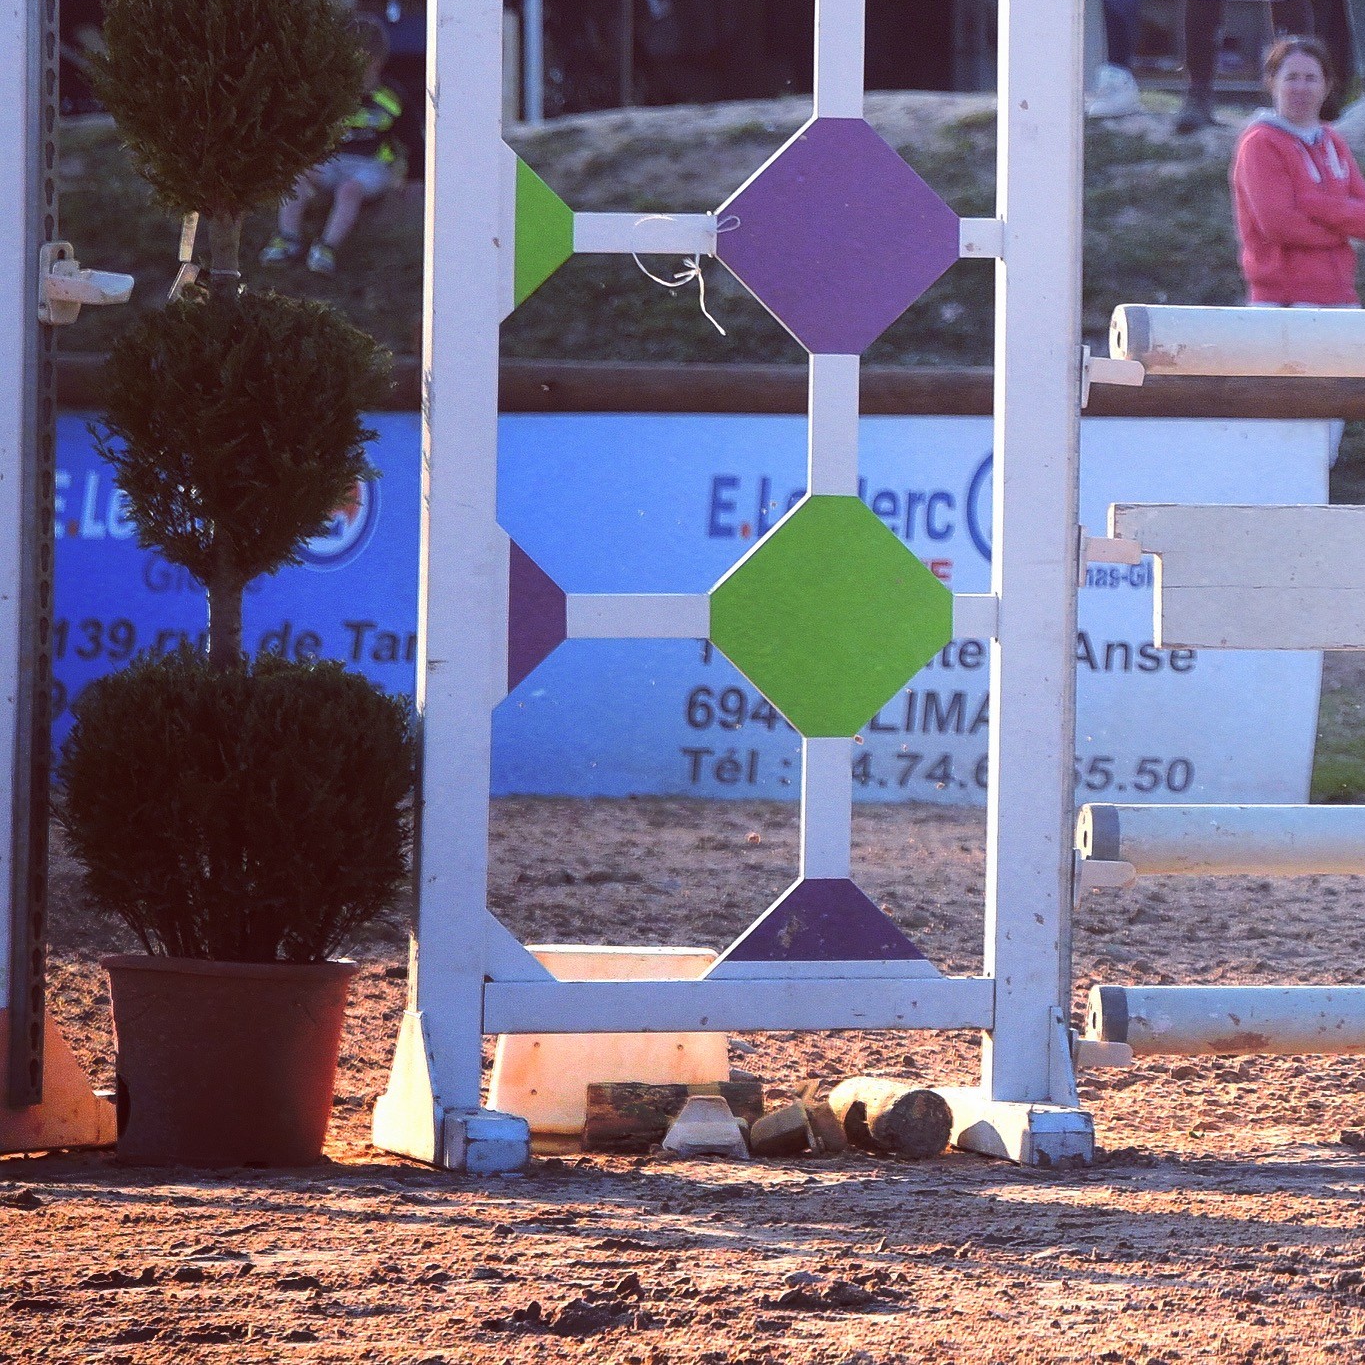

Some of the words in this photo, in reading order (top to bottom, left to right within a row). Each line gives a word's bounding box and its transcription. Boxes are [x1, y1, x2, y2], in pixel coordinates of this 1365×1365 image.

[55, 617, 136, 662] 139
[258, 620, 323, 661] de
[686, 686, 800, 733] 694
[682, 747, 759, 785] Tél
